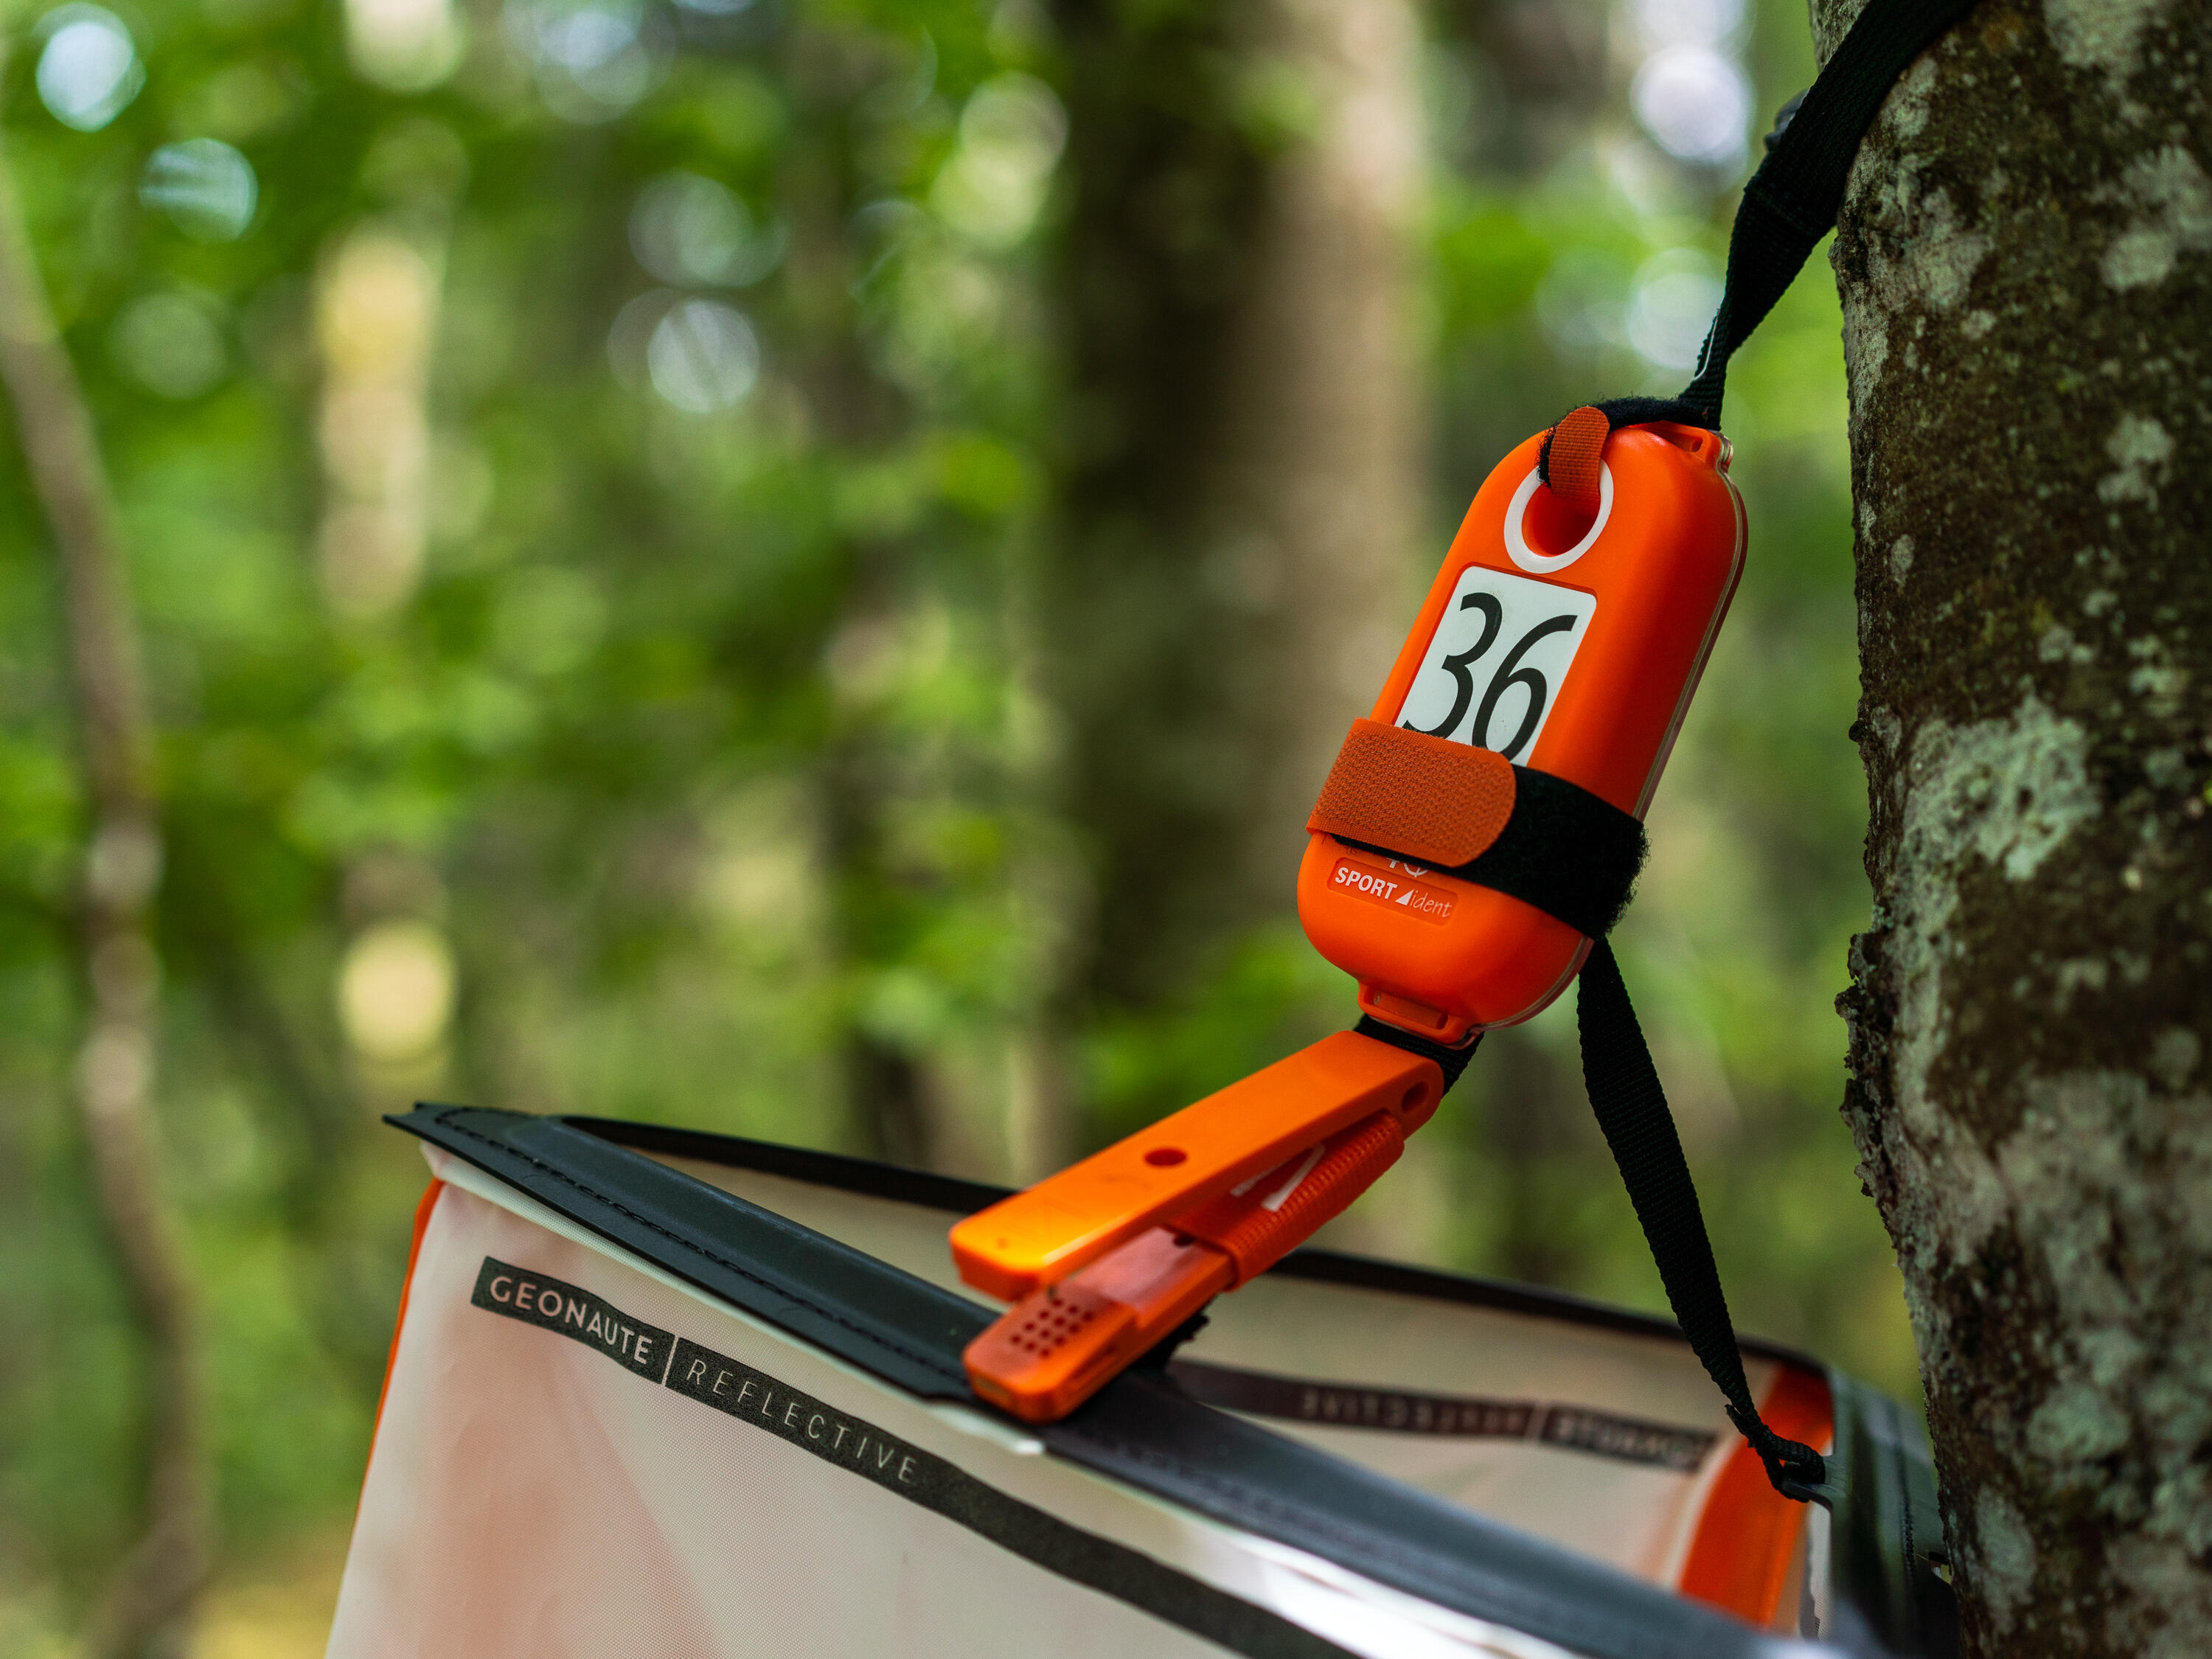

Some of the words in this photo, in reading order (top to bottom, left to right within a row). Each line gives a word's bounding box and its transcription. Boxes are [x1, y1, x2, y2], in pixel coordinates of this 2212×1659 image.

[1401, 591, 1578, 762] 36
[1335, 866, 1398, 900] SPORT
[1409, 889, 1453, 918] ident
[490, 1276, 653, 1365] GEONAUTE
[686, 1358, 917, 1484] REFLECTIVE
